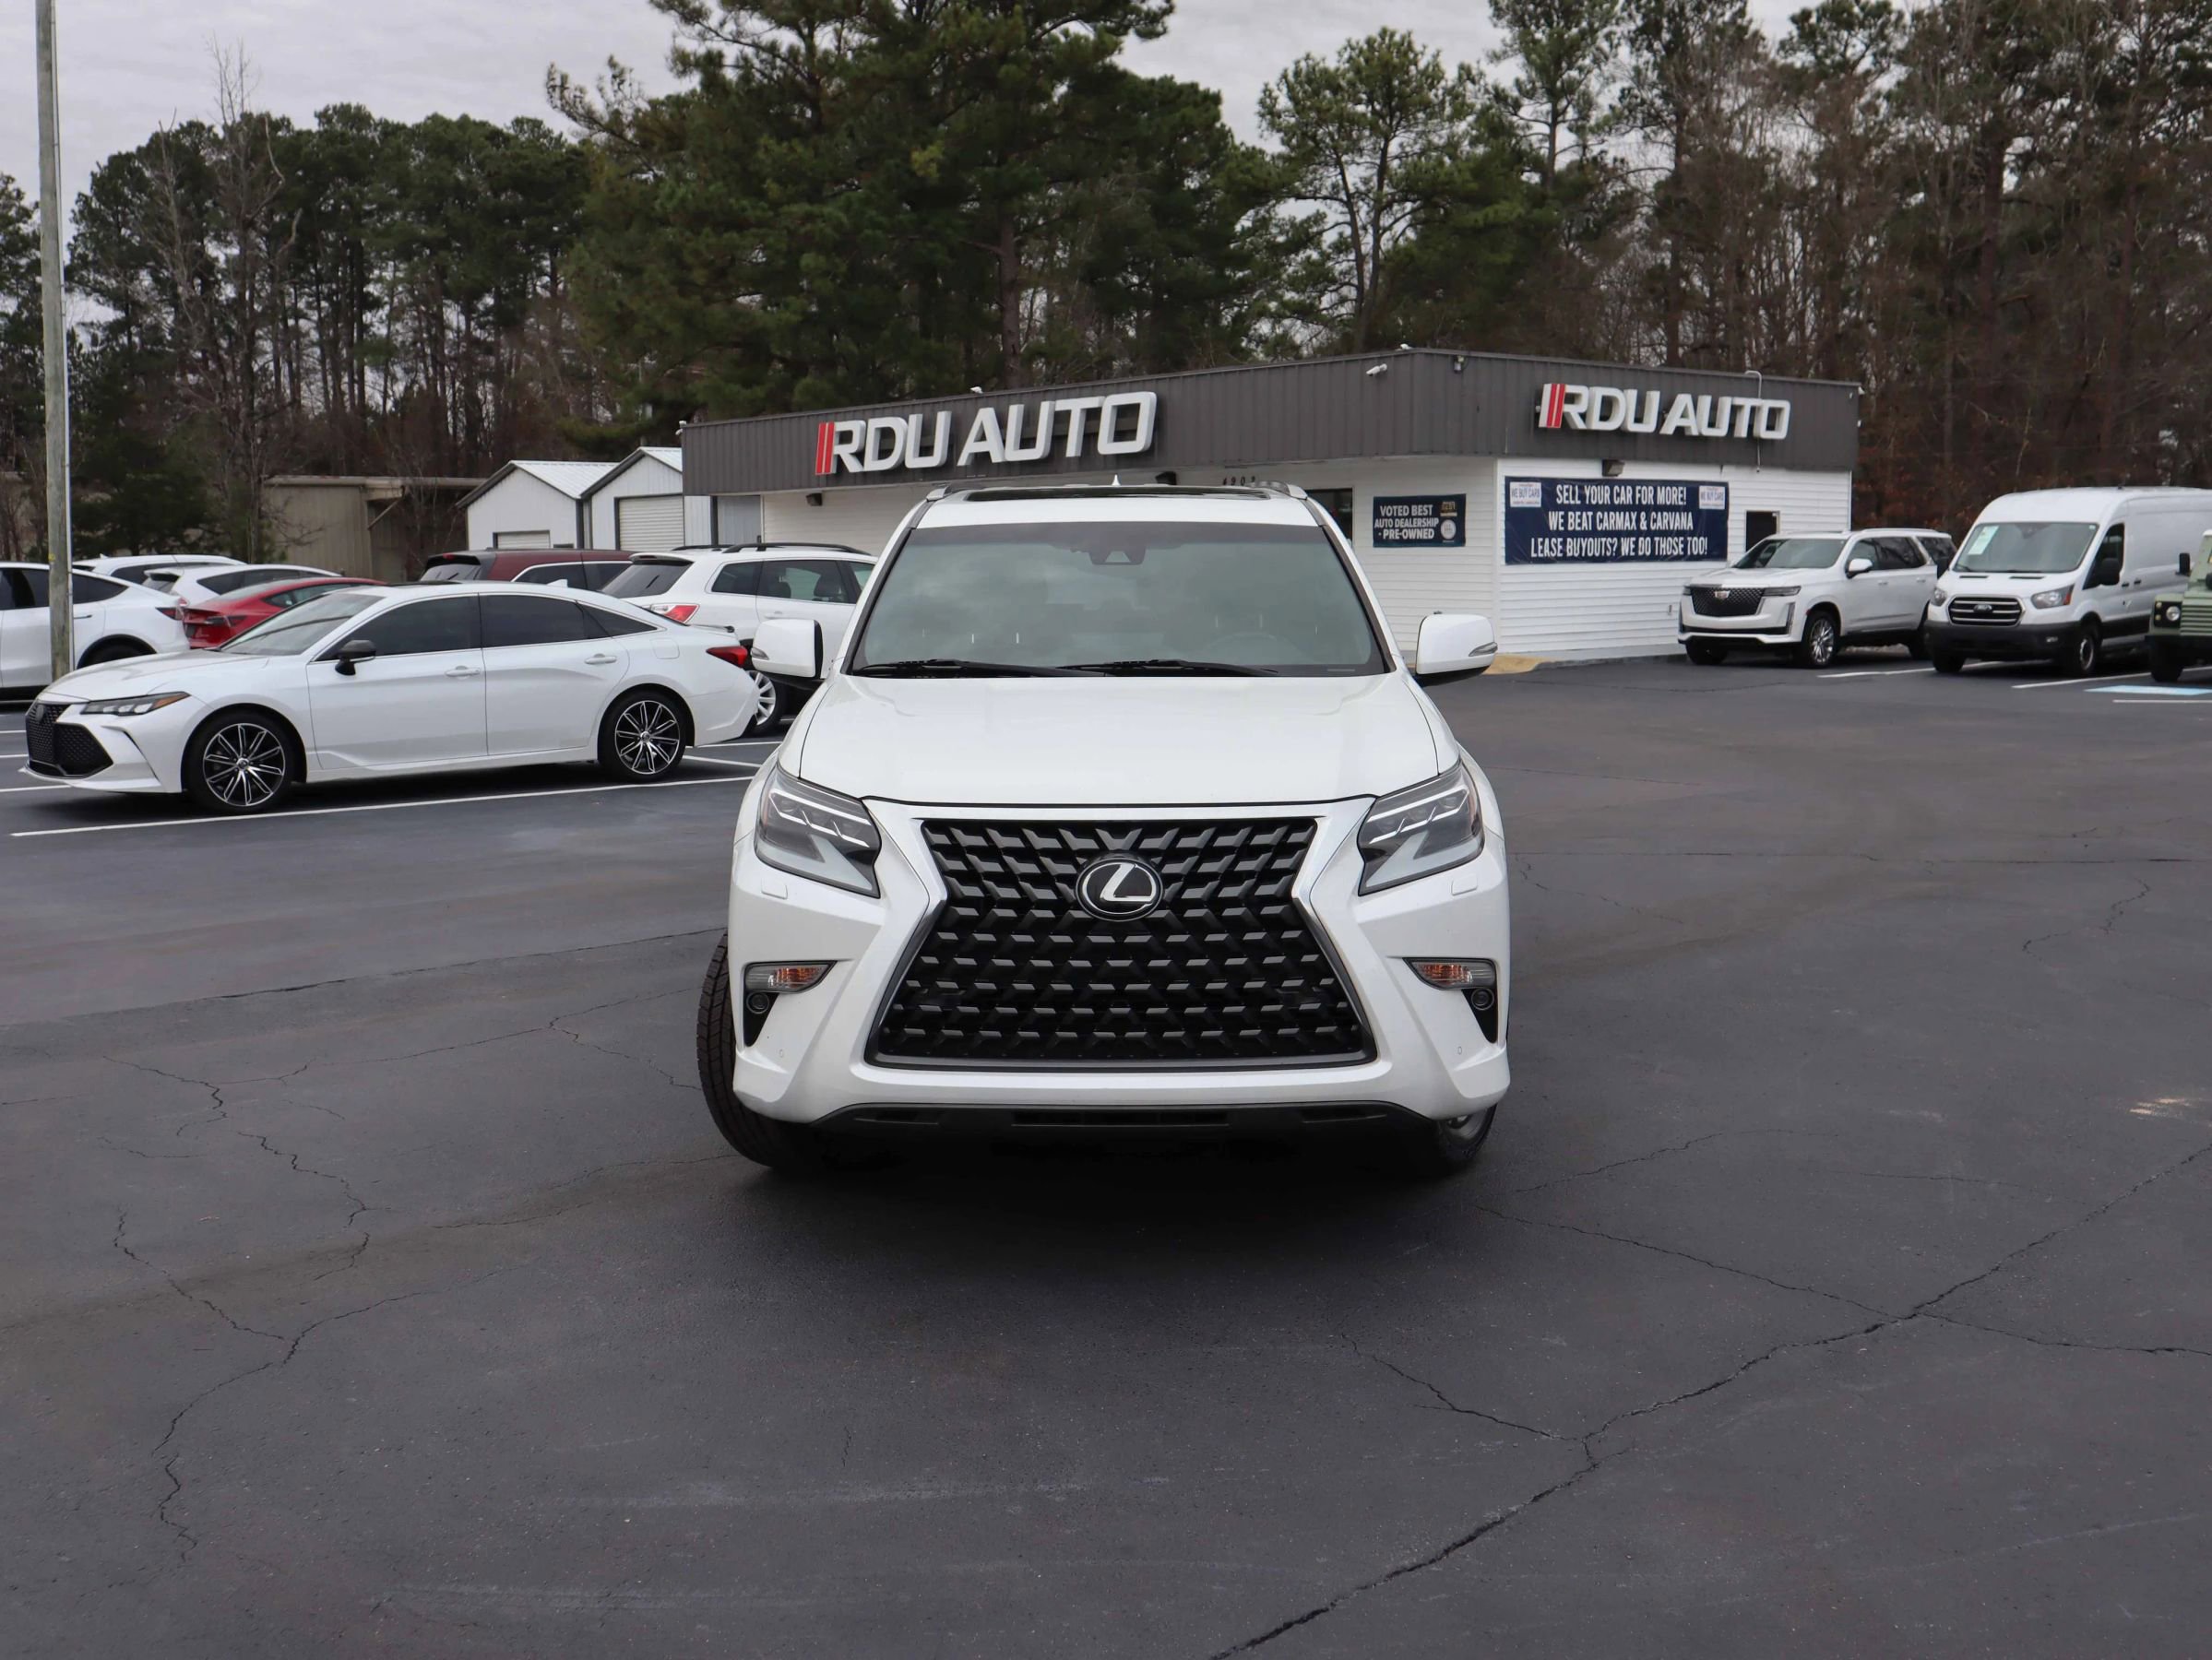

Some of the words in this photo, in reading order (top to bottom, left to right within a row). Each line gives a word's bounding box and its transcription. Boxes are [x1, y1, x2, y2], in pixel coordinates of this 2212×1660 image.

[1562, 384, 1660, 433] RDU
[1659, 393, 1791, 440] AUTO
[832, 410, 953, 473] RDU
[957, 390, 1158, 467] AUTO
[1556, 484, 1581, 504] SELL
[1584, 485, 1611, 504] YOUR
[1613, 485, 1633, 504] CAR
[1635, 485, 1654, 505] FOR
[1657, 486, 1687, 505] MORE!
[1380, 505, 1409, 516] VOTED
[1410, 504, 1433, 516] BEST
[1374, 518, 1394, 528] AUTO
[1394, 517, 1439, 528] DEALERSHIP
[1549, 511, 1565, 530] WE
[1568, 511, 1593, 530] BEAT
[1596, 511, 1637, 530] CARMAX
[1639, 512, 1647, 530] &
[1650, 512, 1694, 530] CARVANA
[1383, 528, 1434, 540] PRE-OWNED
[1531, 538, 1564, 558] LEASE
[1566, 537, 1618, 557] BUYOUTS?
[1621, 537, 1636, 556] WE
[1638, 537, 1651, 556] DO
[1654, 537, 1684, 556] THOSE
[1686, 537, 1708, 556] TOO!
